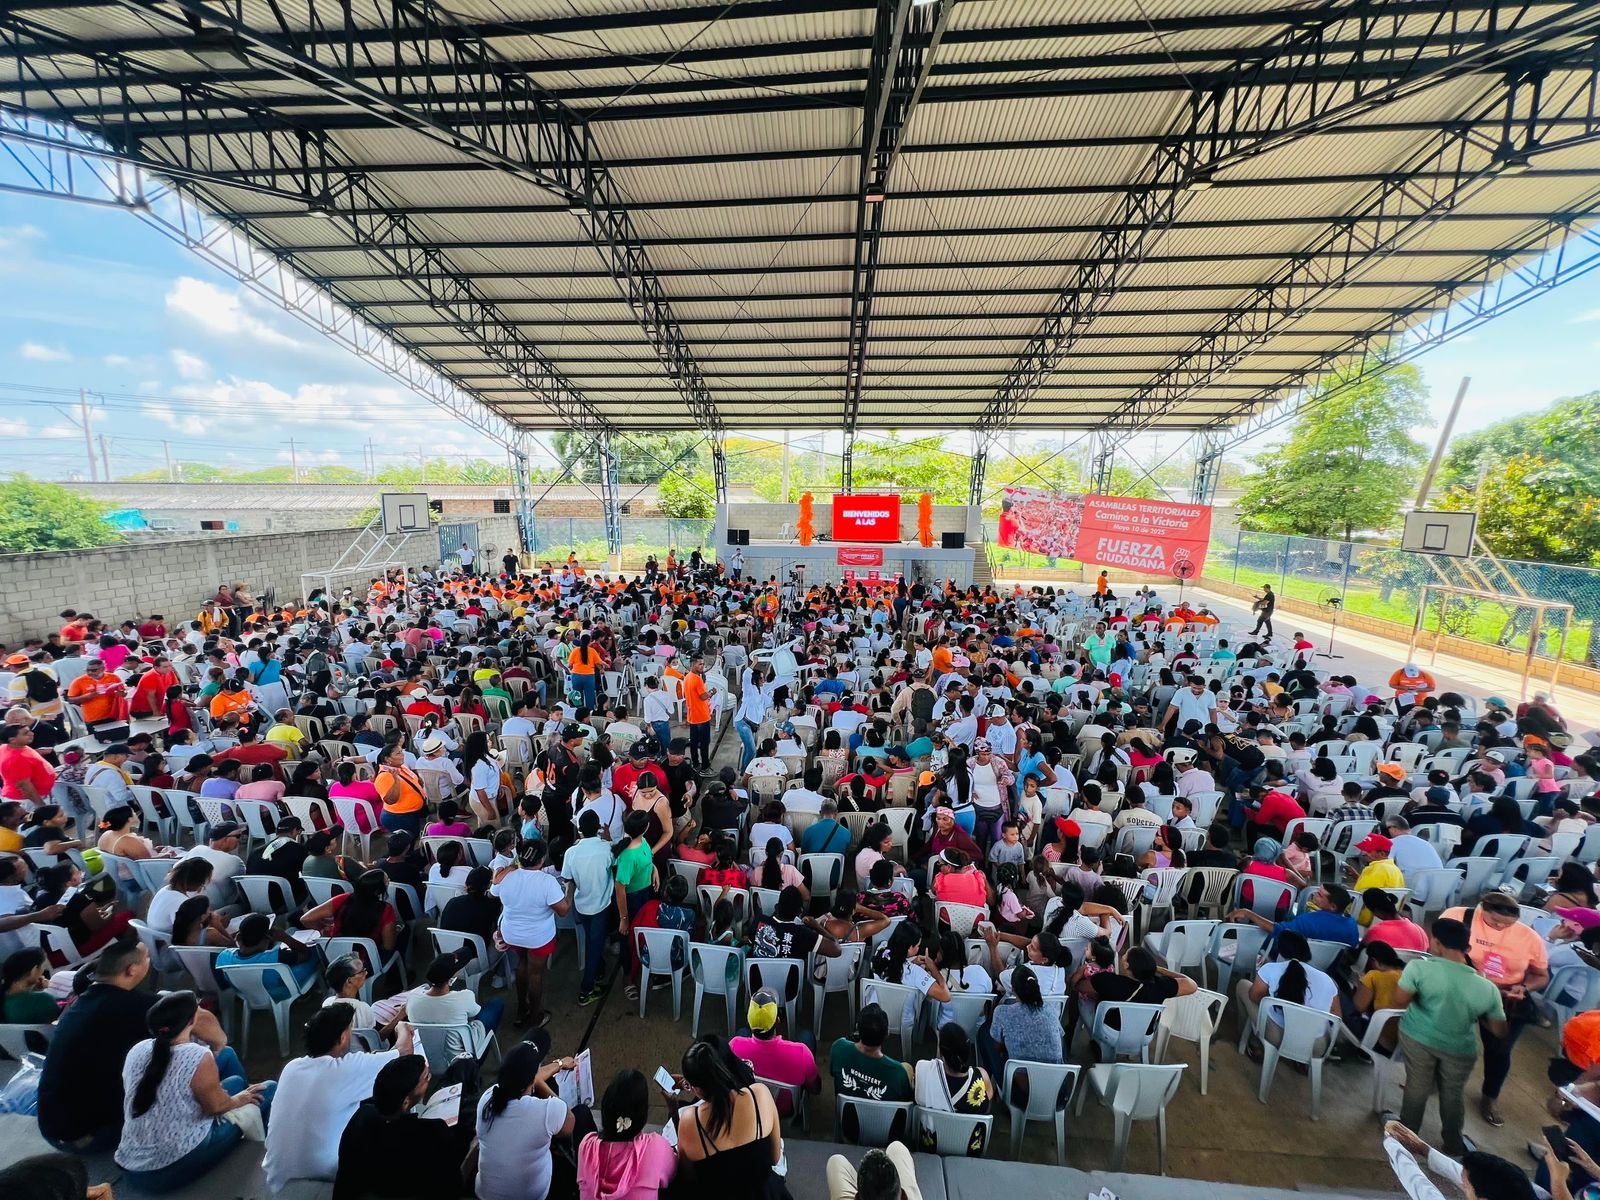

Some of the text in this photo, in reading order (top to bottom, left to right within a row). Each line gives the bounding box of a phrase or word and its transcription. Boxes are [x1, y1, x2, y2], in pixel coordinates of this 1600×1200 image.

[843, 510, 890, 518] BIENVENIDOS
[1089, 500, 1201, 517] ASAMBLEAS TERRITORIALES
[862, 518, 876, 526] LAS
[1095, 510, 1188, 528] Camino a la Victoria
[1113, 524, 1130, 532] Mayo
[1097, 537, 1164, 560] FUERZA
[1096, 551, 1166, 569] CIUDADANA
[781, 932, 793, 958] 東京
[850, 1068, 881, 1086] MONASTERY
